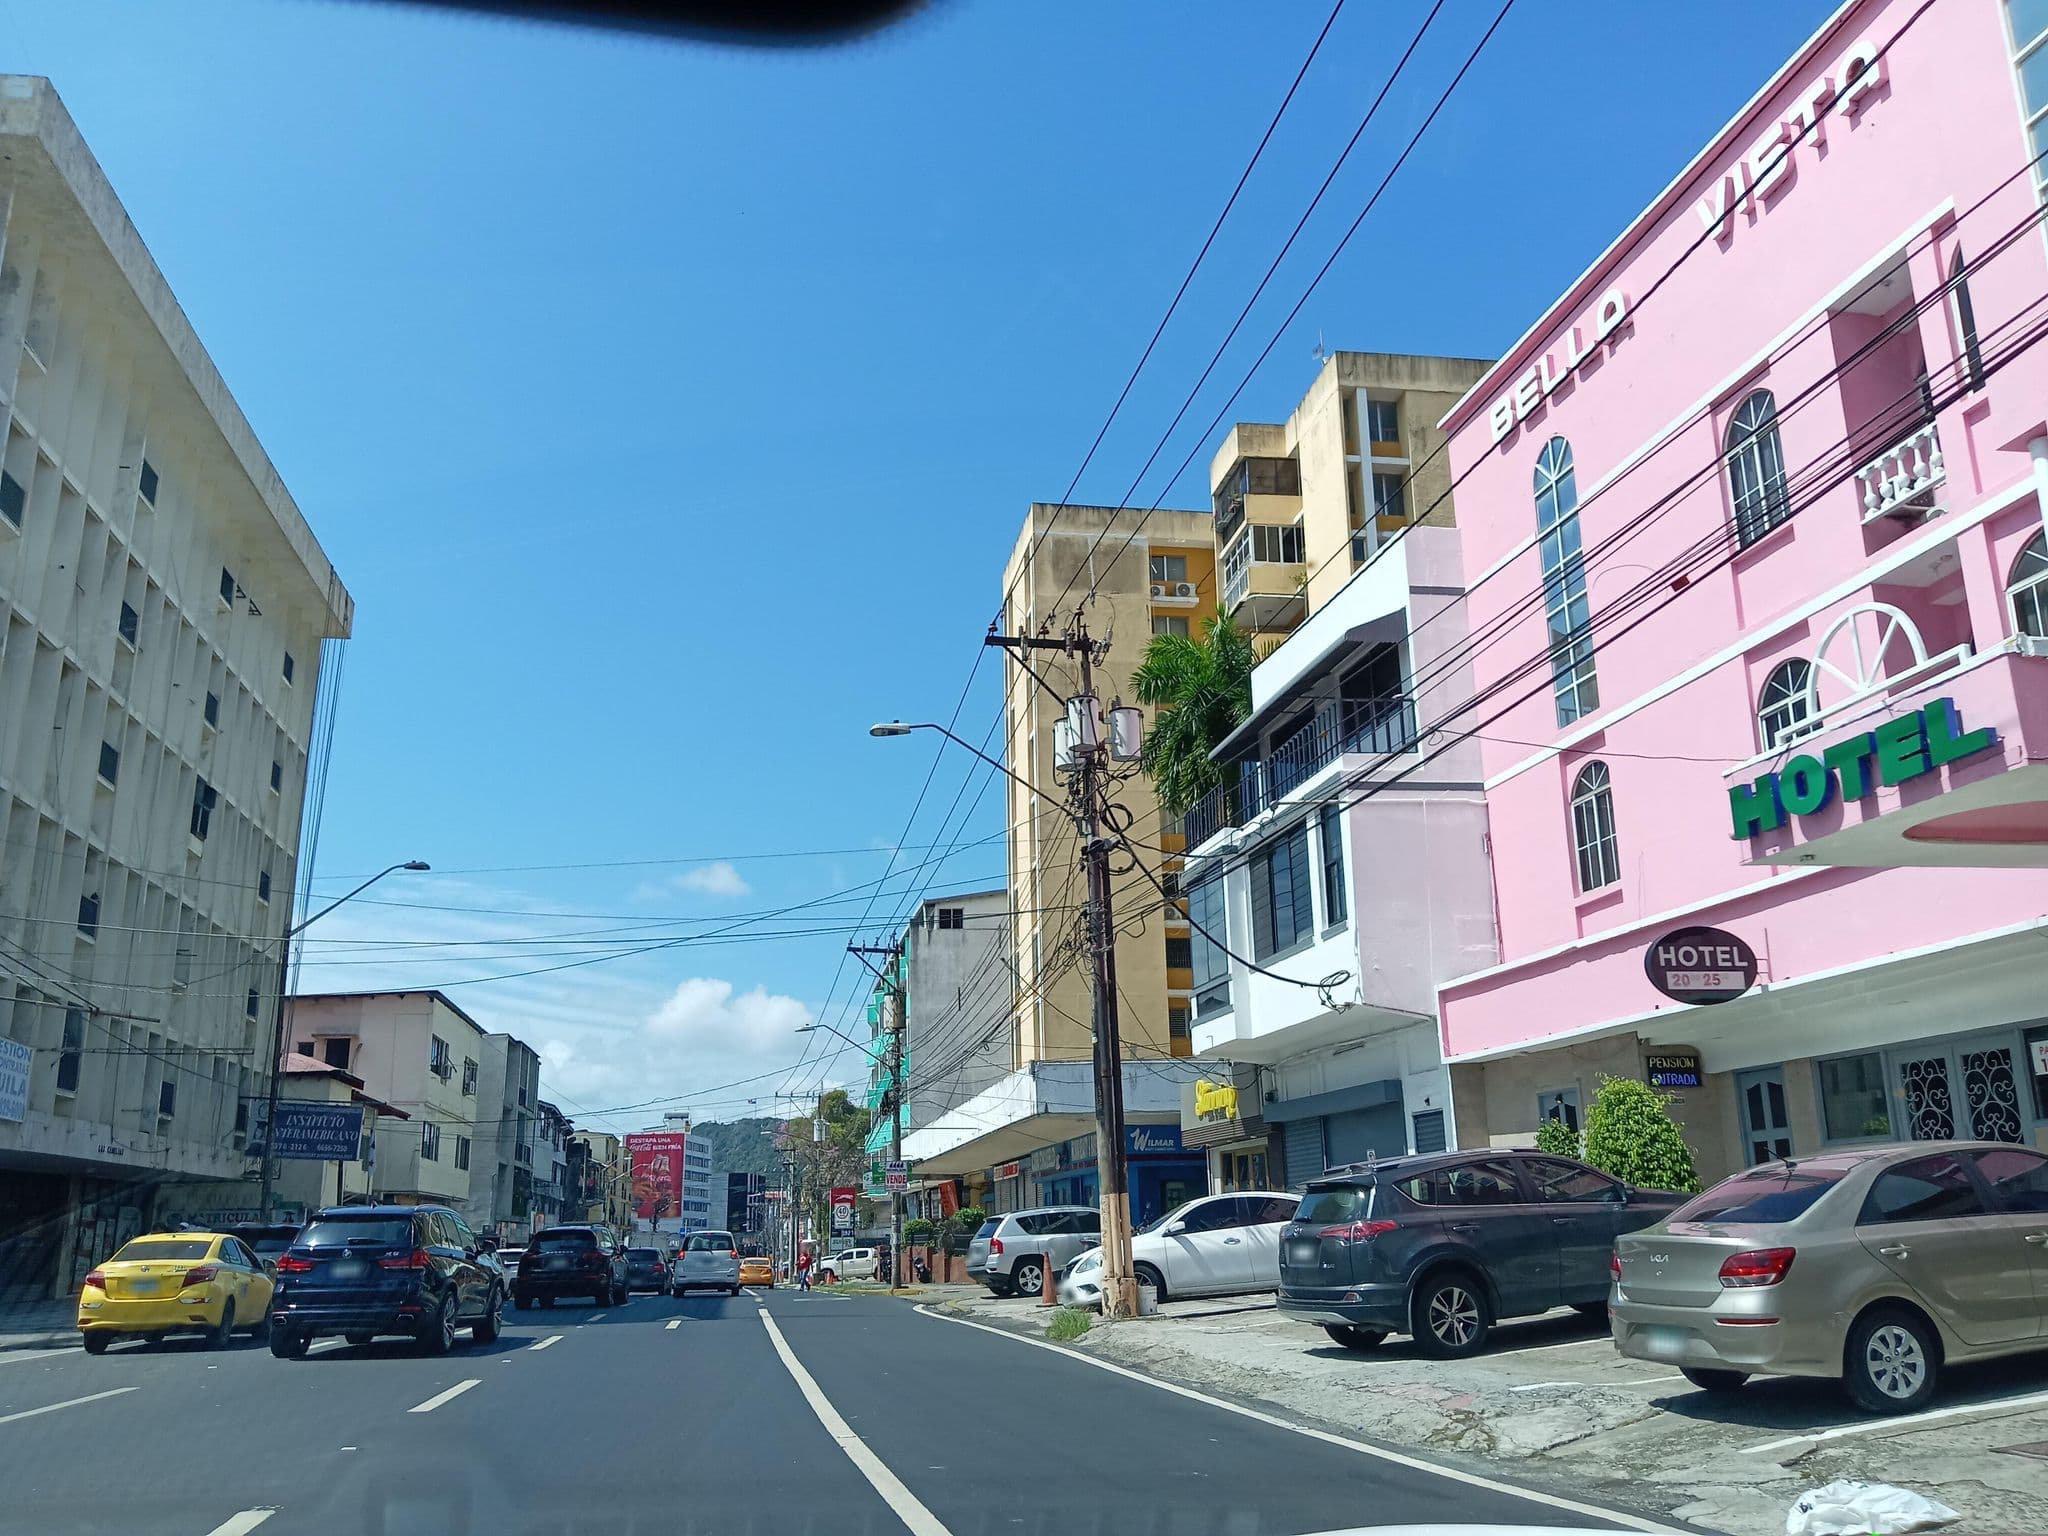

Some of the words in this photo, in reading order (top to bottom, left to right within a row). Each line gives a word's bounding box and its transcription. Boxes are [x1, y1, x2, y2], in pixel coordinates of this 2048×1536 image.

[1489, 288, 1631, 446] BELLA
[1694, 40, 1890, 243] VISTA
[1729, 697, 1997, 841] HOTEL
[1658, 945, 1748, 967] HOTEL
[1649, 1056, 1695, 1069] PENSION
[286, 1114, 345, 1128] INSTITUTO
[272, 1127, 359, 1141] NTERAMERICANO
[1130, 1128, 1174, 1151] WILMAR
[886, 1174, 906, 1184] VENDE
